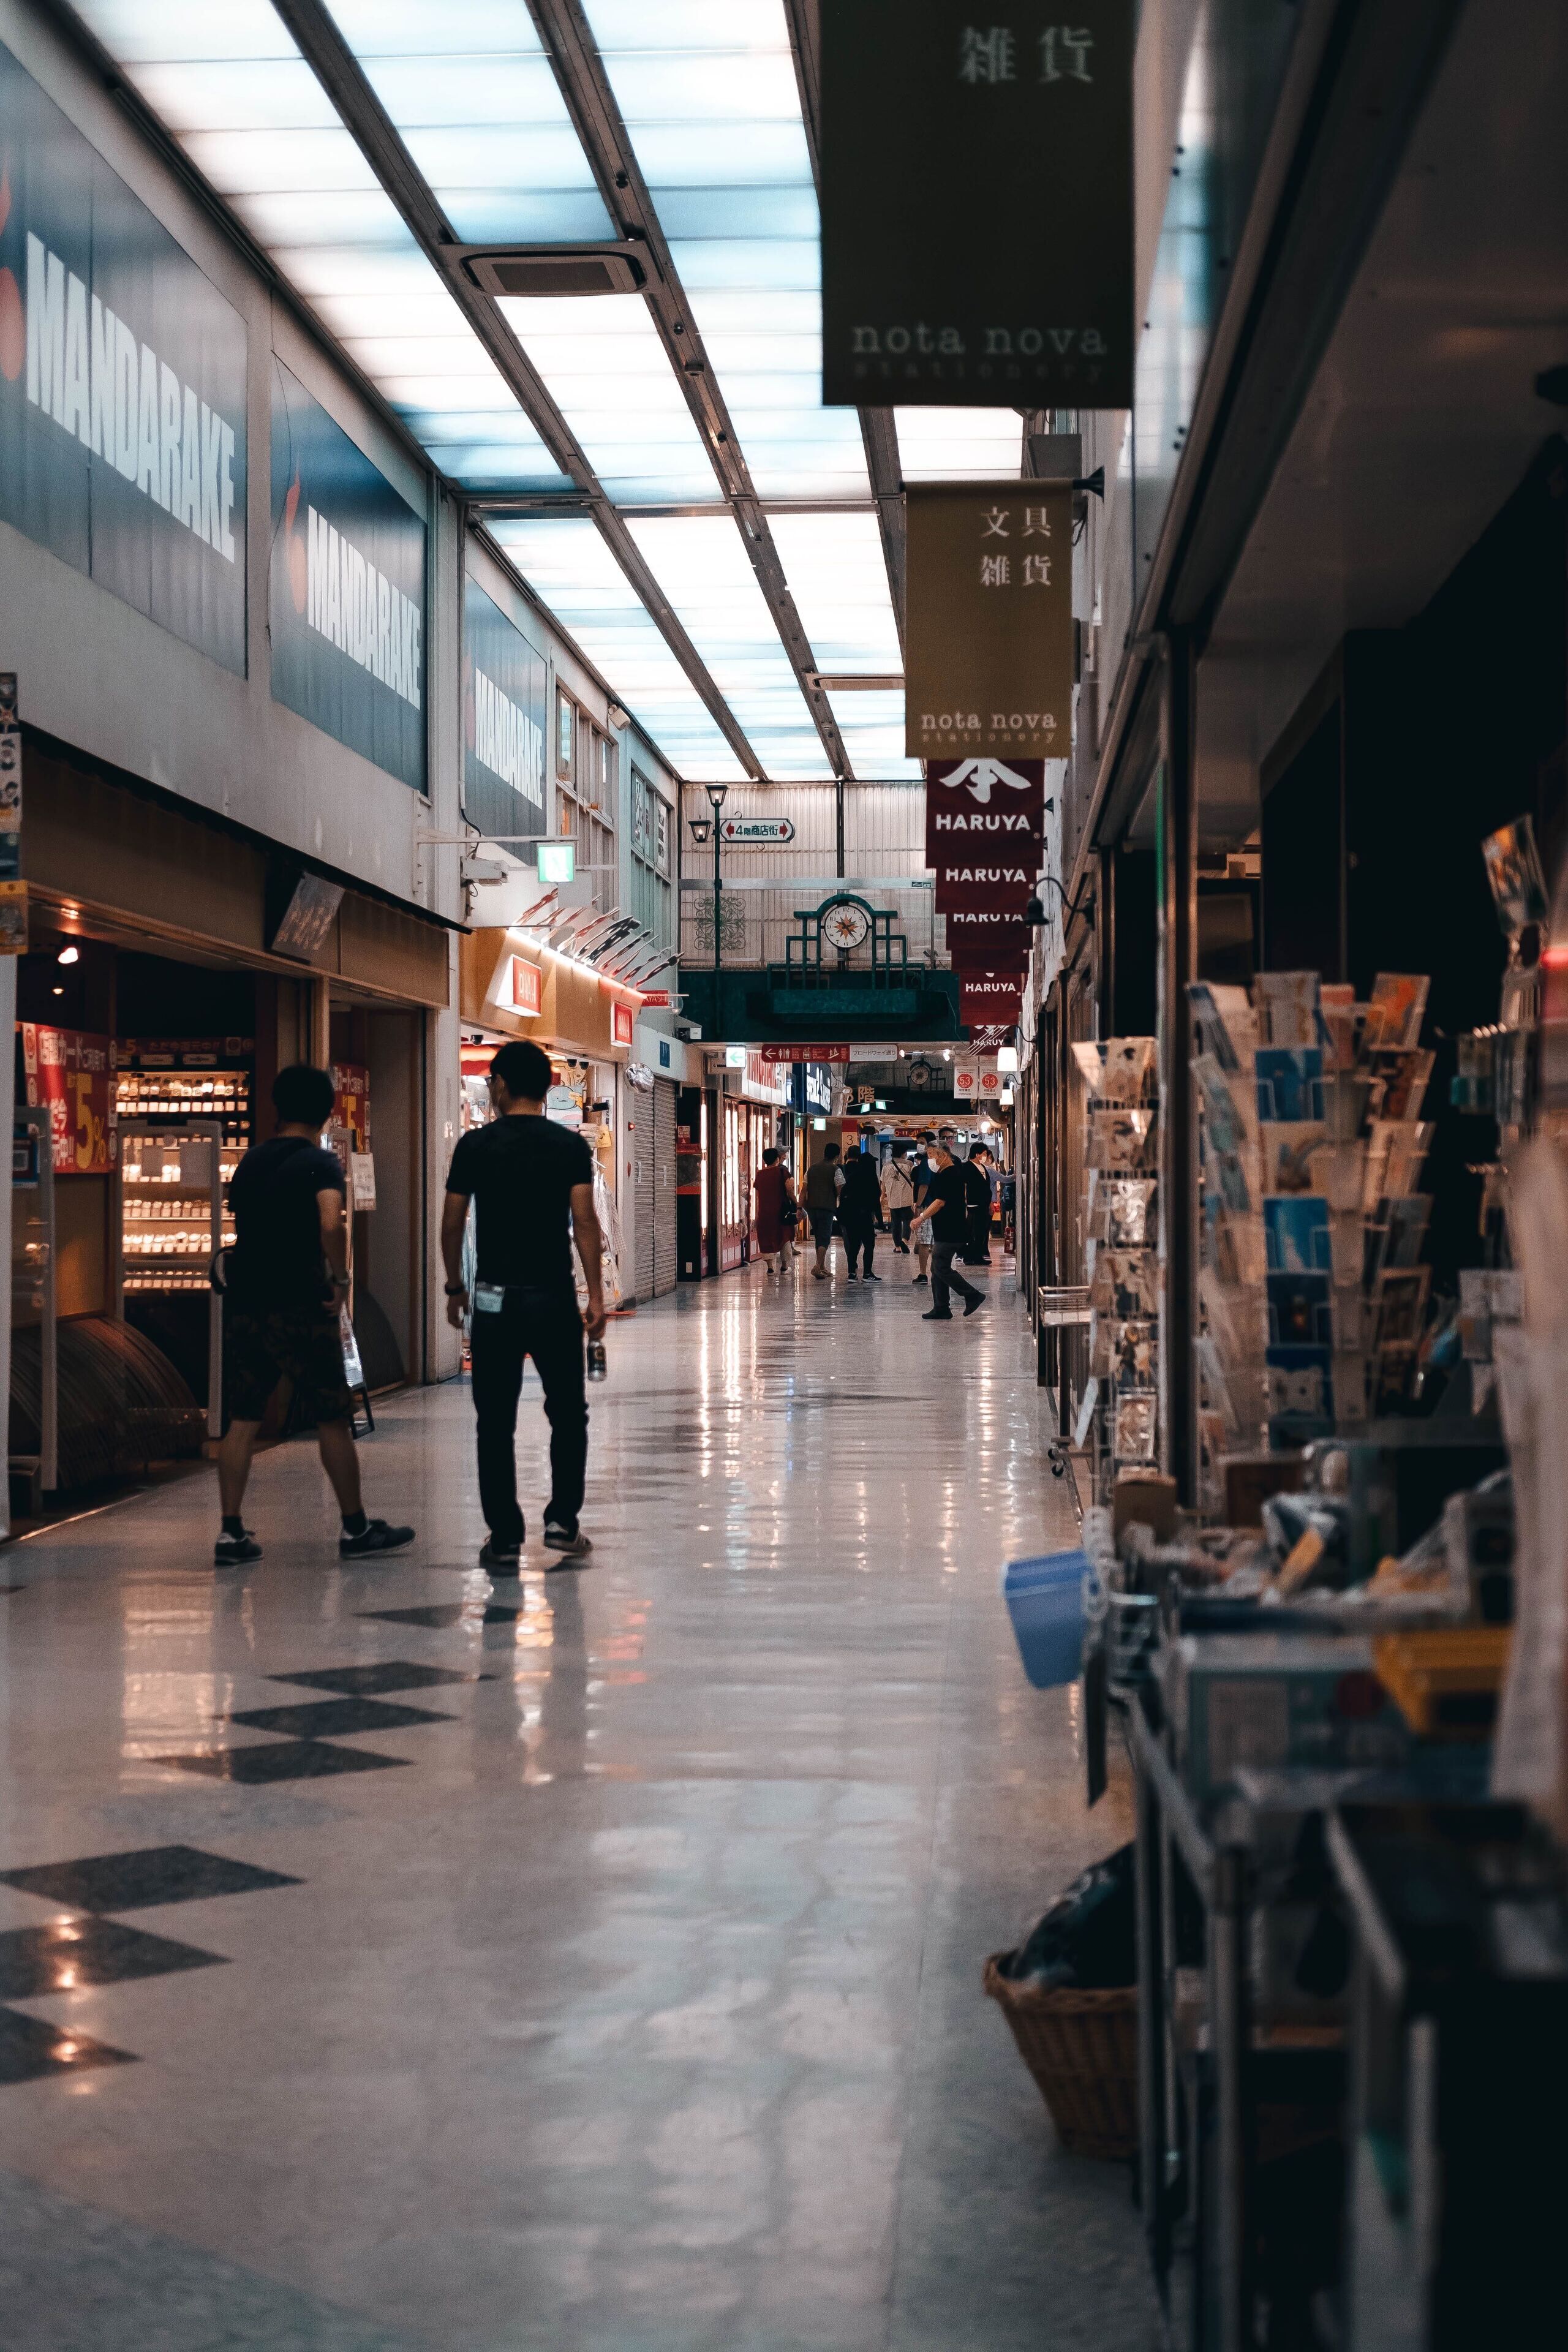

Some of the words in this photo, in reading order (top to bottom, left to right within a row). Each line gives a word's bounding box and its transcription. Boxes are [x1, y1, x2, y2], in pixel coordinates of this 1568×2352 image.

[958, 25, 1095, 85] 雑貨
[851, 322, 965, 356] nota
[985, 325, 1107, 356] nova
[26, 232, 236, 564] MANDARAKE
[980, 506, 1052, 538] 文具
[980, 554, 1052, 587] 雑貨
[307, 505, 421, 710] MANDARAKE
[921, 710, 981, 730] nota
[990, 712, 1057, 729] nova
[475, 667, 543, 810] MANDARAKE
[735, 824, 778, 836] 4階商店街
[935, 813, 1031, 831] HARUYA
[946, 868, 1027, 883] HARUYA
[965, 983, 1016, 992] HARUYA
[960, 1077, 971, 1085] 53
[984, 1077, 995, 1085] 53
[77, 1072, 107, 1170] 5%
[846, 1134, 853, 1145] 3
